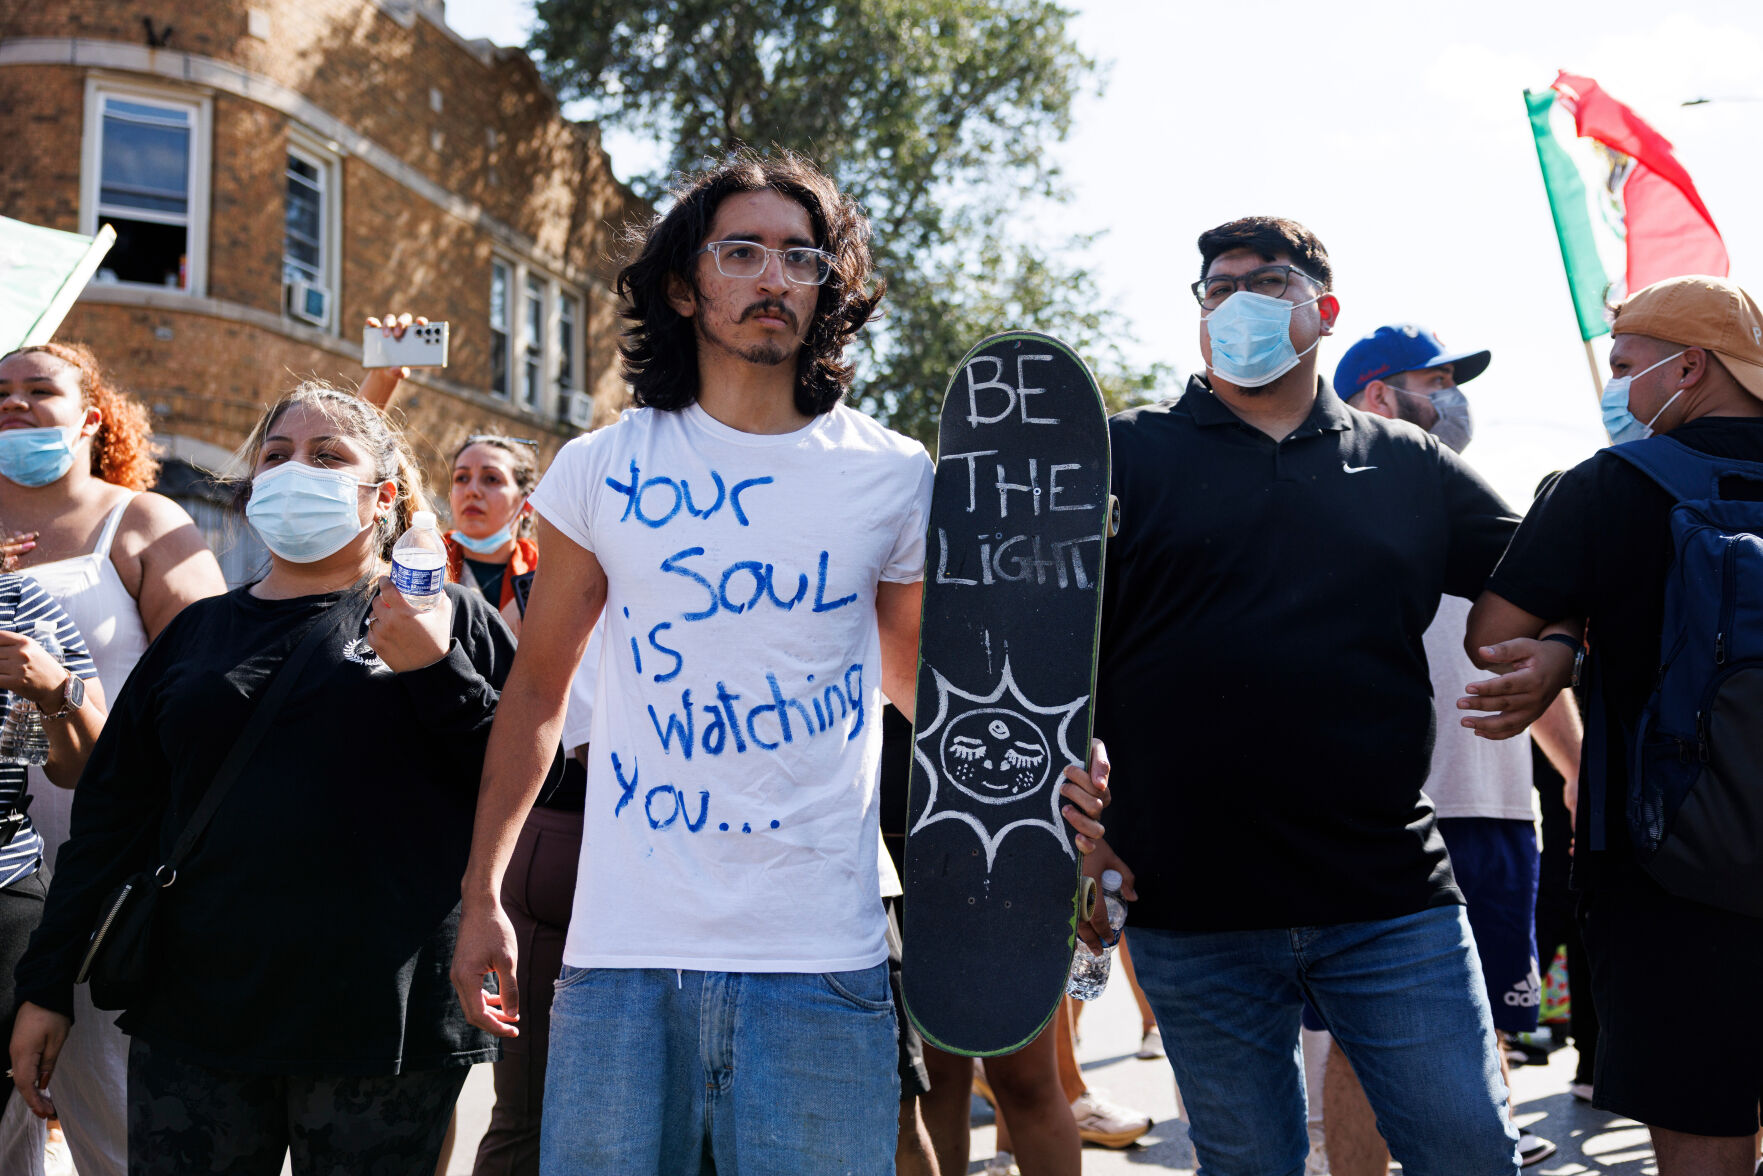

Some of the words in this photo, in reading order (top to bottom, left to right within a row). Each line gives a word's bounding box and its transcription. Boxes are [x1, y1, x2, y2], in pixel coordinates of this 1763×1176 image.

[965, 354, 1060, 429] BE
[940, 450, 1096, 519] THE
[659, 545, 858, 622] SOUL
